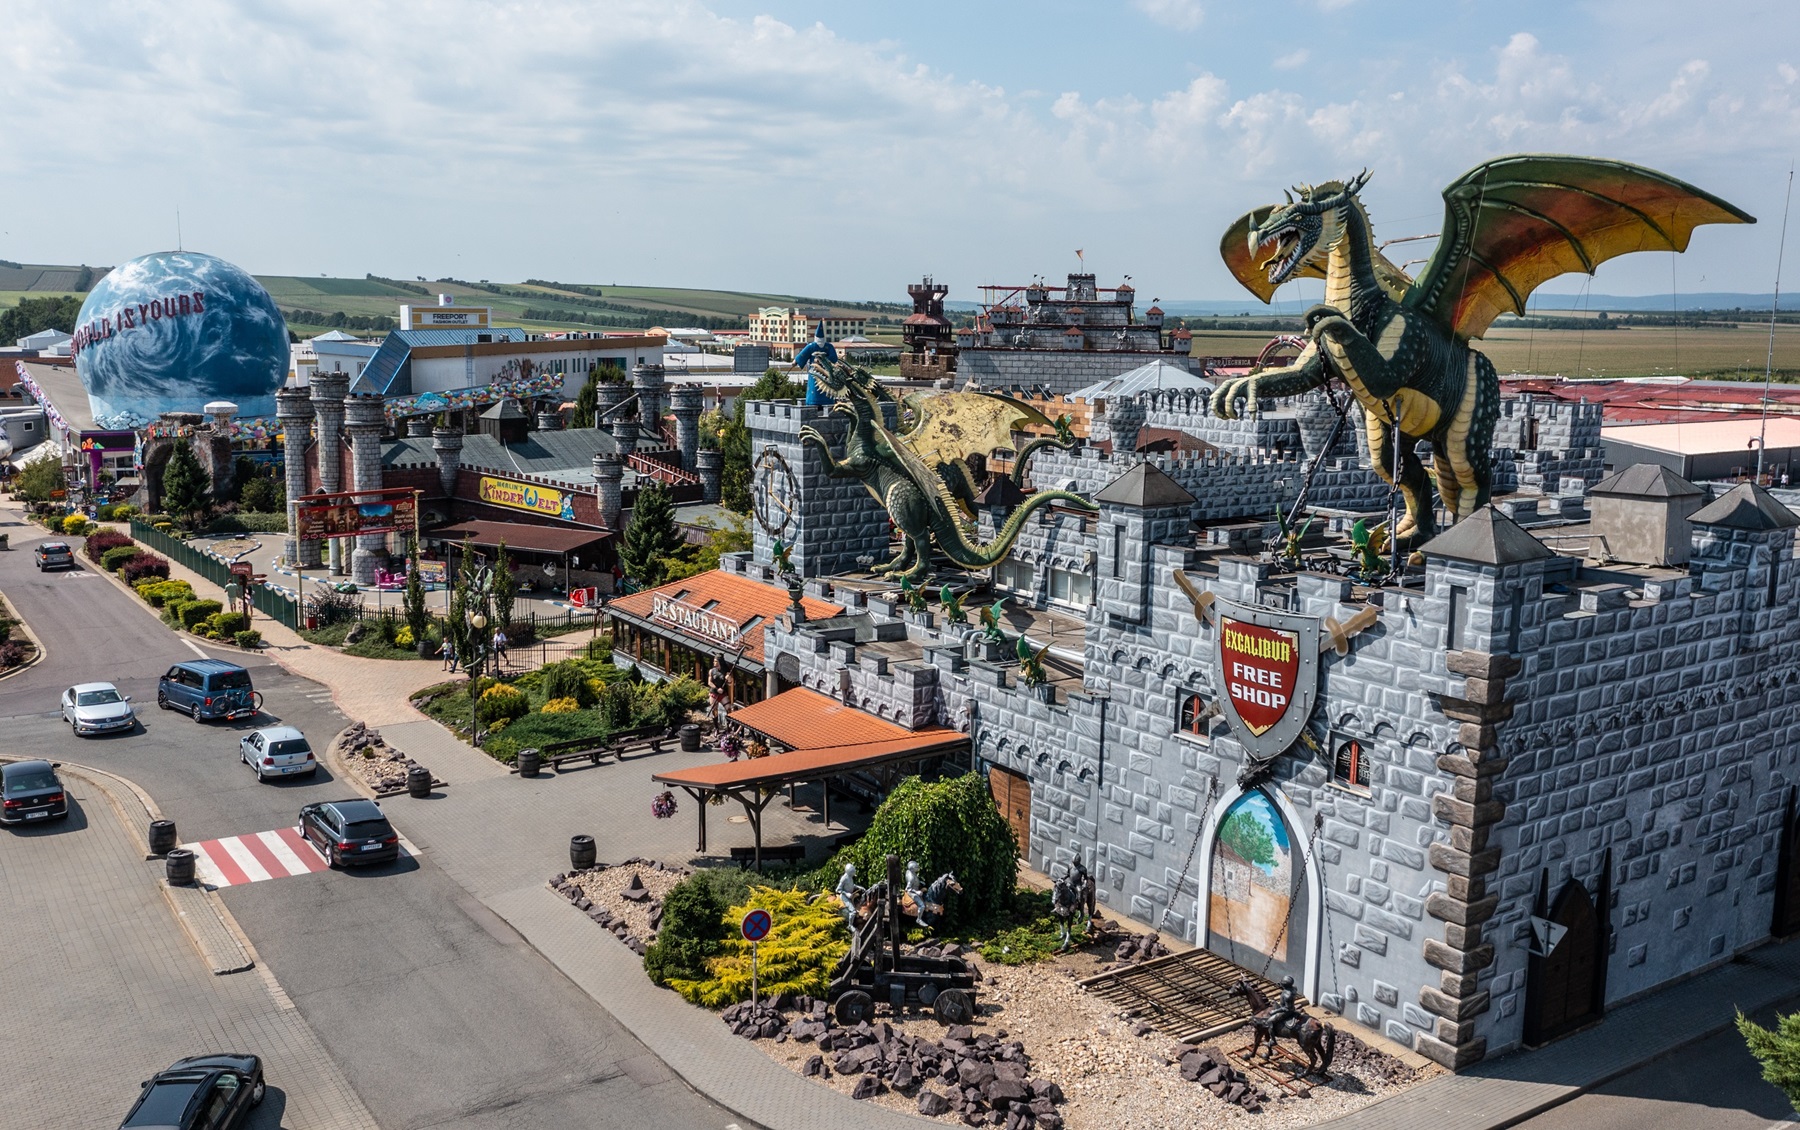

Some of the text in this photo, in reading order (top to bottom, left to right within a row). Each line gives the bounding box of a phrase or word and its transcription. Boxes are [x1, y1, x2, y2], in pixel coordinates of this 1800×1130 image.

[117, 308, 135, 333] IS
[138, 292, 204, 325] YOURS
[496, 480, 523, 492] MERLIN'S
[653, 596, 738, 645] RESTAURANT
[1225, 627, 1291, 663] EXCALIBUR
[1233, 661, 1282, 689] FREE
[1231, 682, 1286, 709] SHOP
